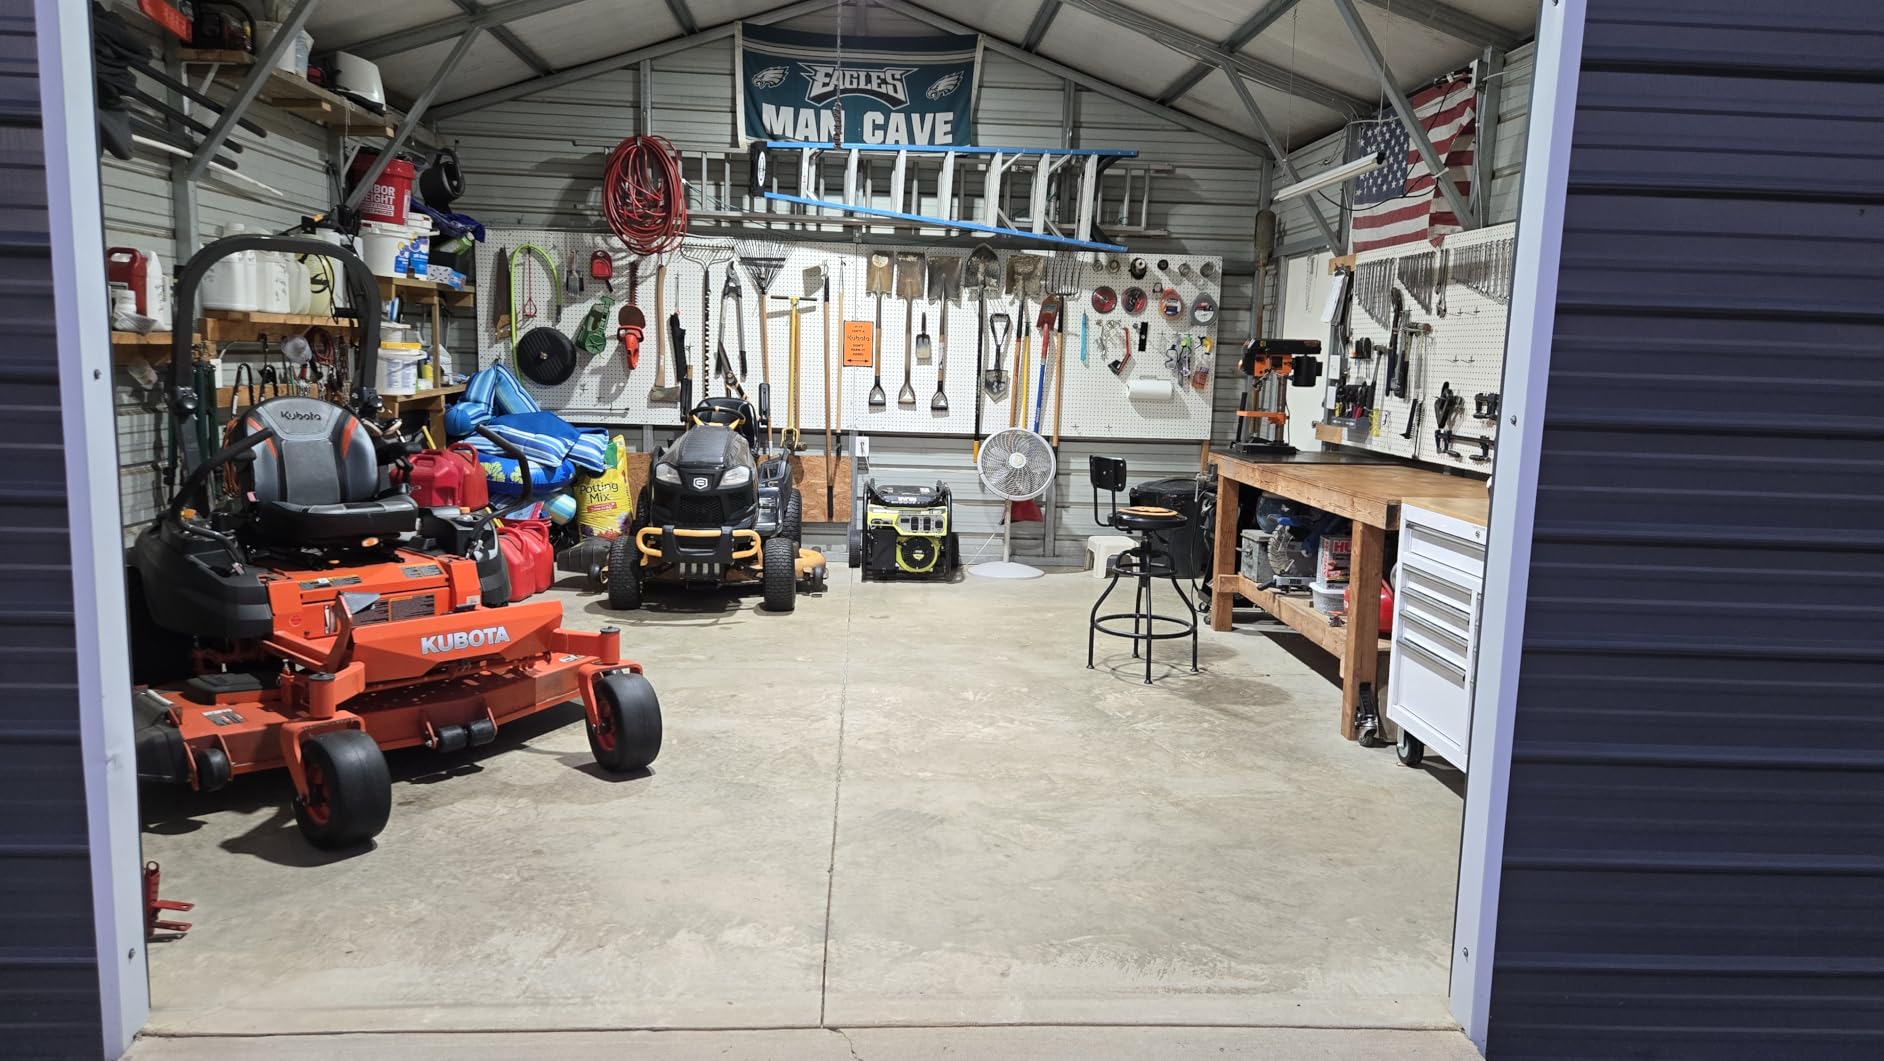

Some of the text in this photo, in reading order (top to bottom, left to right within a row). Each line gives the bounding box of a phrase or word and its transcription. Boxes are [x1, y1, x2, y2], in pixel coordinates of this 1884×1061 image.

[809, 64, 906, 98] EAGLES
[761, 103, 954, 145] MAN CAVE
[280, 410, 322, 421] Kubota
[580, 482, 618, 494] Potting
[590, 493, 610, 503] Mix
[420, 626, 511, 656] KUBOTA
